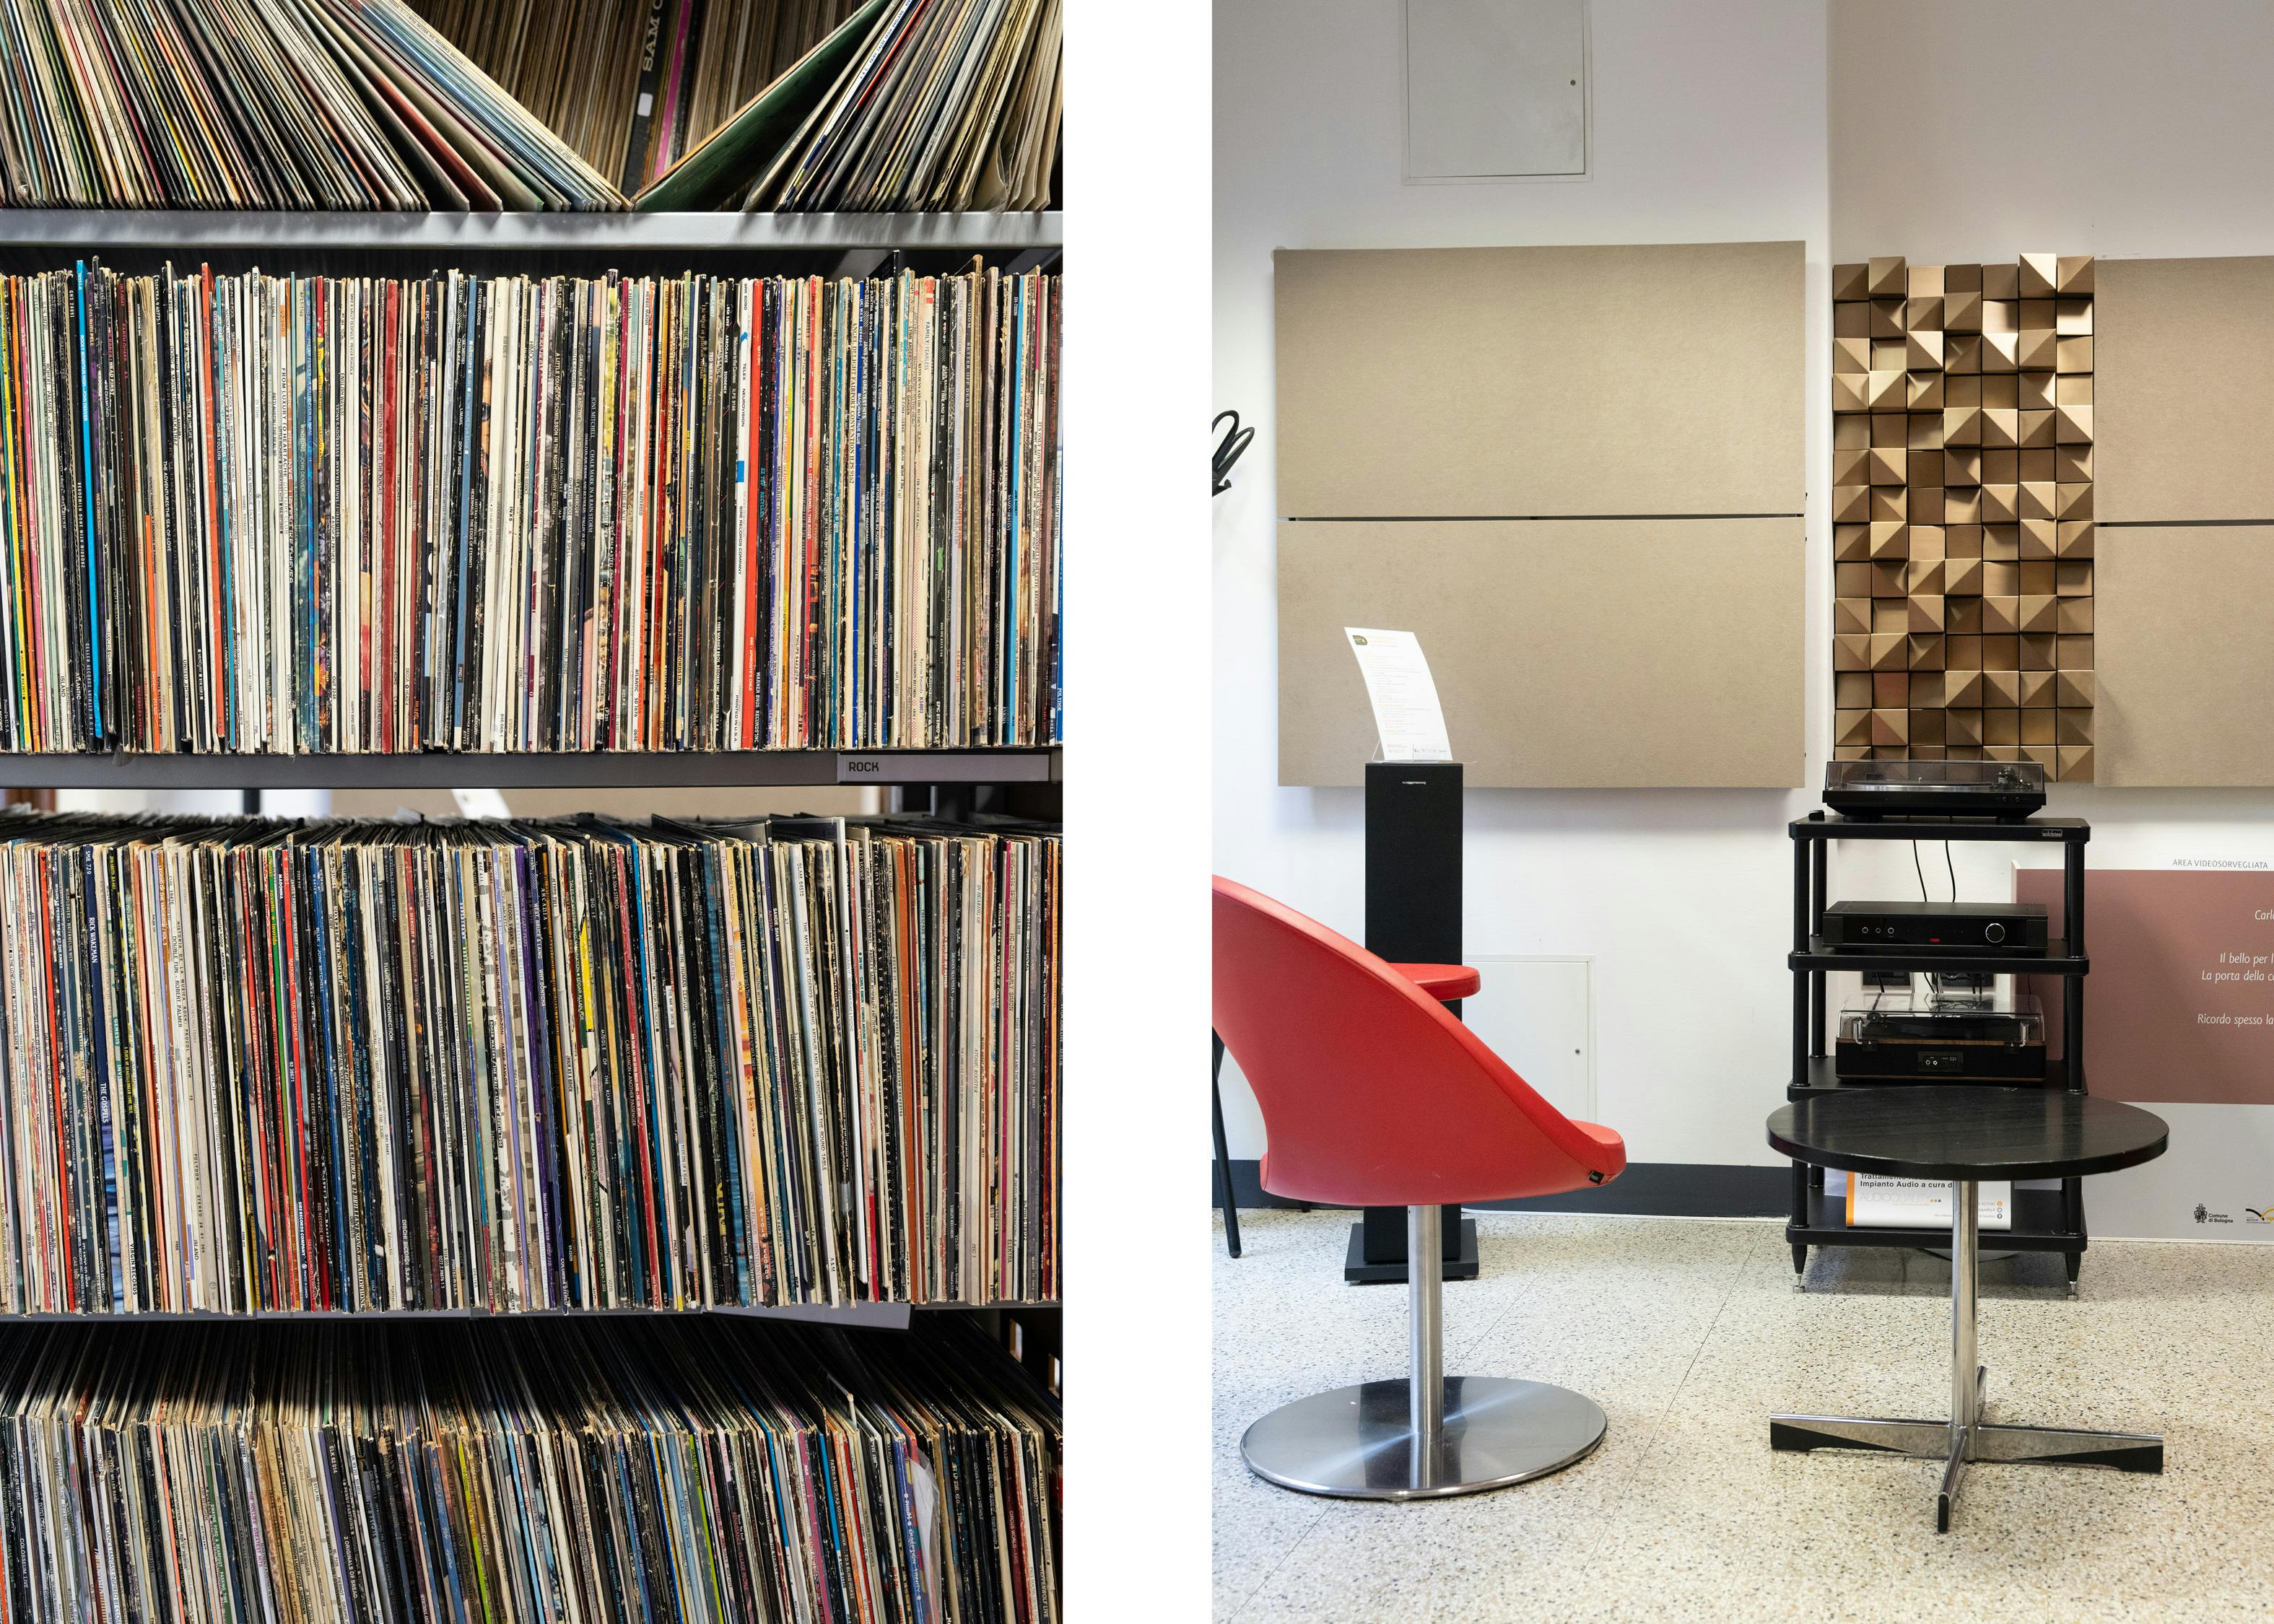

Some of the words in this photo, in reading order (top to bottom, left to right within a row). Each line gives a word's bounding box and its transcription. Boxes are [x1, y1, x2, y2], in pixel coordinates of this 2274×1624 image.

[642, 16, 661, 72] SAM
[848, 761, 879, 772] ROCK
[2194, 860, 2268, 869] VIDEOSORVEGLIATA
[2220, 952, 2226, 964] Il
[2229, 952, 2250, 964] bello
[2253, 956, 2268, 967] per
[2202, 970, 2212, 980] La
[2215, 971, 2240, 984] porta
[2243, 970, 2264, 981] della
[2197, 1013, 2231, 1024] Ricordo
[2234, 1016, 2262, 1028] spesso
[100, 1096, 109, 1122] GOSPELS
[367, 1513, 376, 1538] RASCALS
[481, 1534, 489, 1554] CRYERS
[344, 1541, 353, 1570] ORIGINALS
[298, 1590, 306, 1614] SUNDOWN
